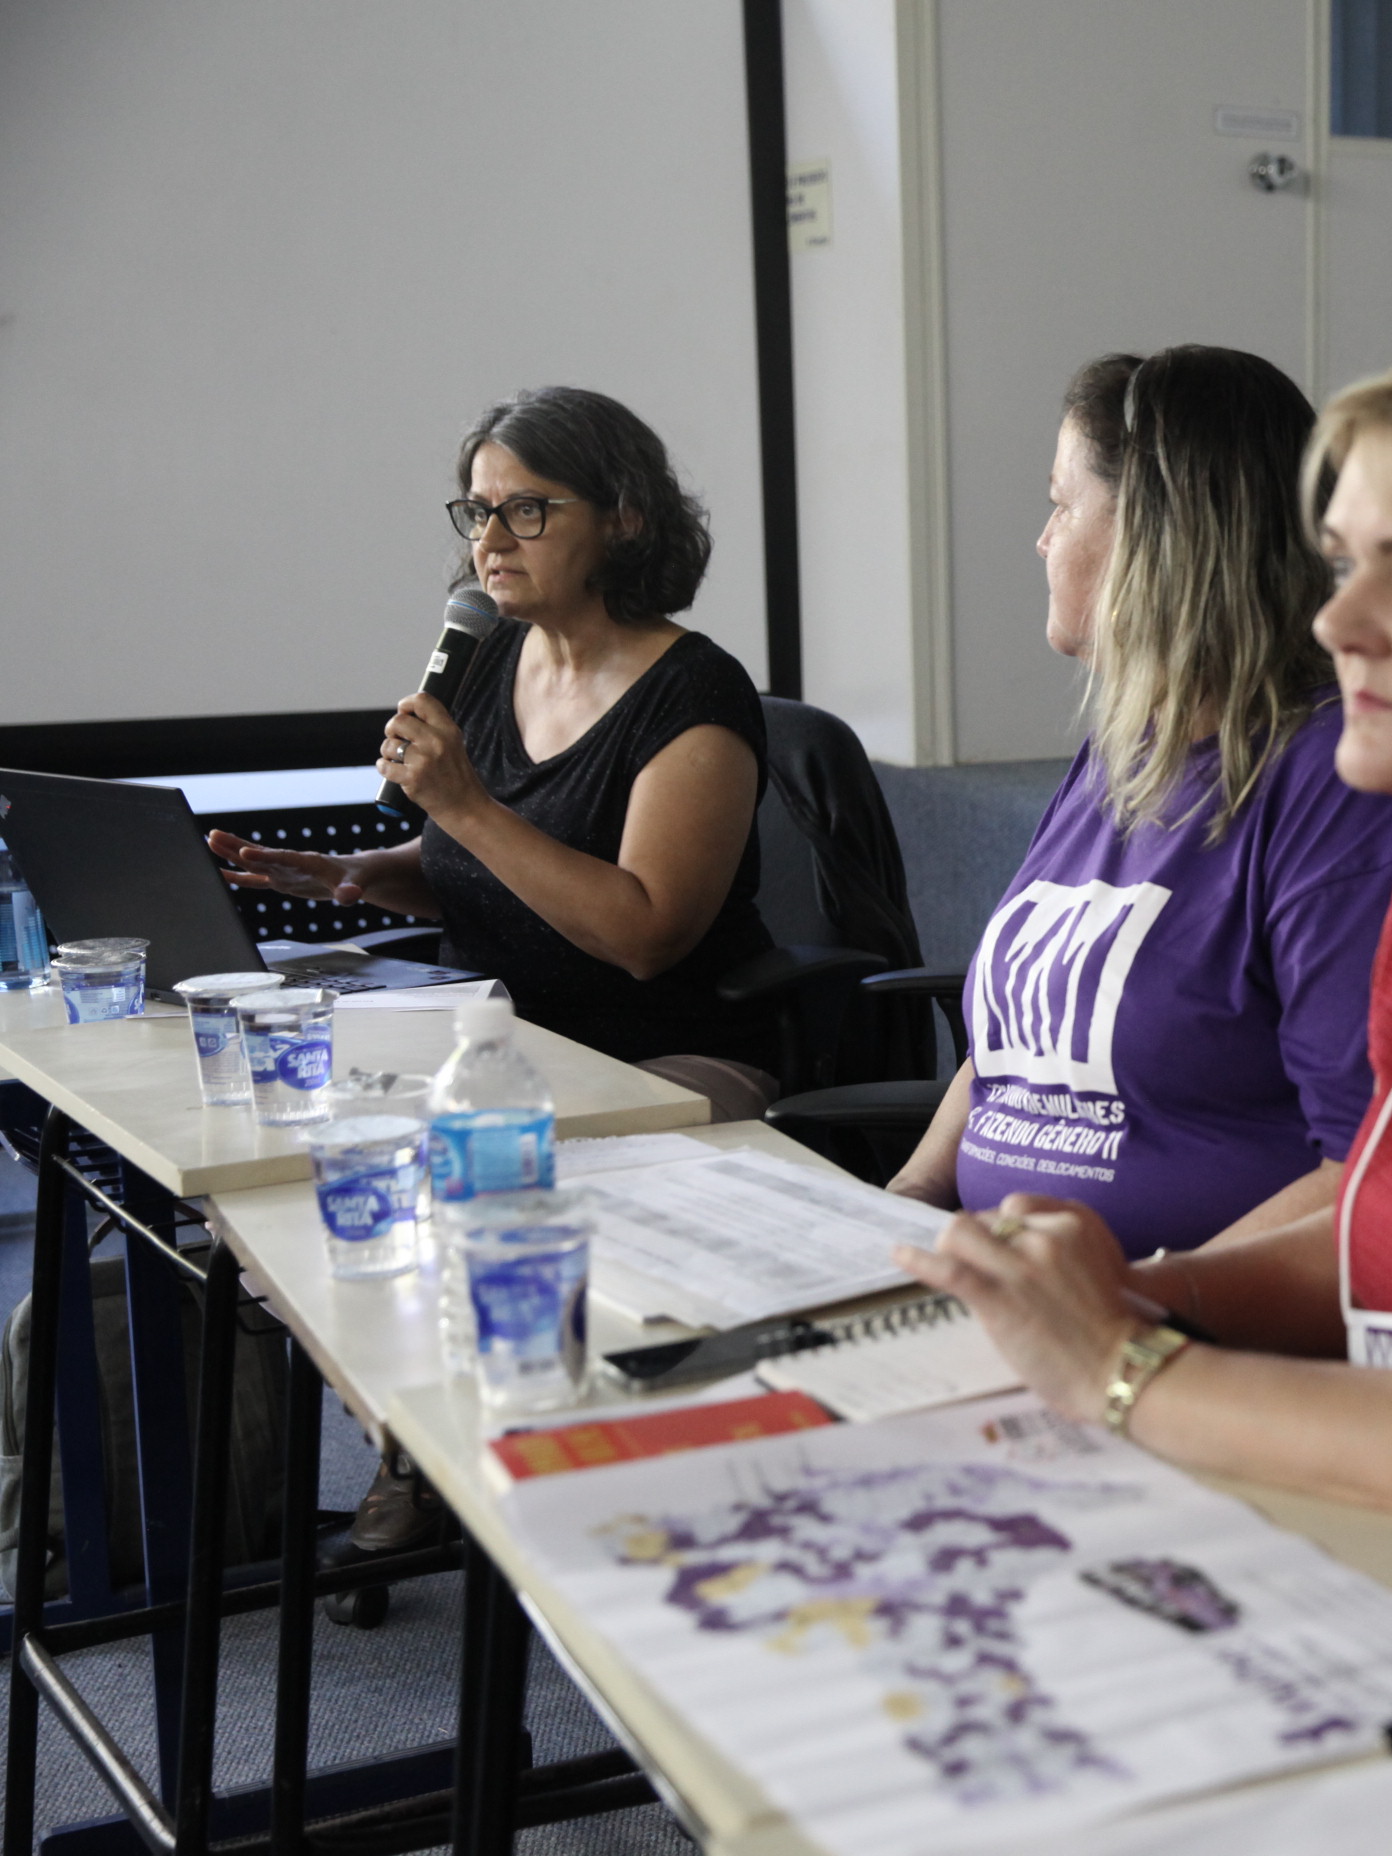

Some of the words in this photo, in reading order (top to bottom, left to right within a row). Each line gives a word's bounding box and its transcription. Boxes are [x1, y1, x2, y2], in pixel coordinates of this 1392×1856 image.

[286, 1048, 329, 1068] SANTA
[297, 1061, 325, 1079] RITA
[974, 1110, 1039, 1147] FAZENDO
[1033, 1119, 1105, 1156] GÊNERO
[1037, 1158, 1116, 1183] DESLOCAMENTOS
[326, 1194, 380, 1212] SANTA
